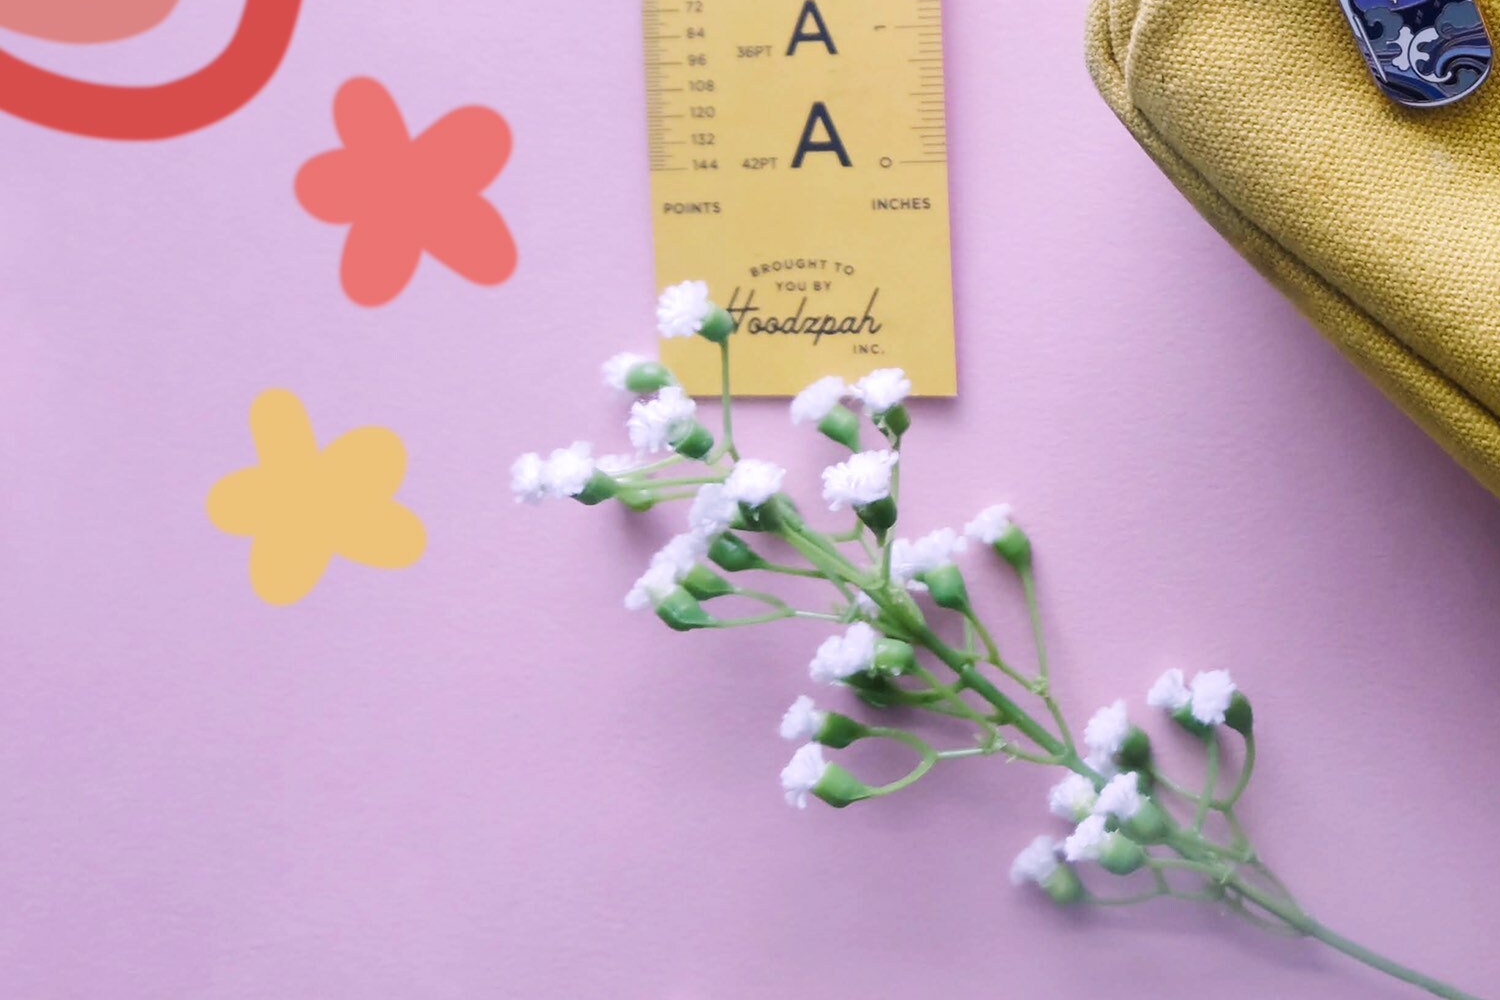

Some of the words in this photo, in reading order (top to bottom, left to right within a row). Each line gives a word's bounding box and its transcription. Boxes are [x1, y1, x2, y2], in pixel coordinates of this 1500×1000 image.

[685, 1, 704, 14] 72
[686, 27, 705, 40] 84
[735, 45, 773, 60] 36PT
[687, 54, 707, 67] 96
[688, 80, 716, 93] 108
[690, 106, 717, 119] 120
[690, 132, 716, 146] 132
[741, 157, 778, 171] 42PT
[790, 101, 853, 169] A
[692, 158, 720, 171] 144
[663, 201, 722, 215] POINTS
[871, 197, 932, 211] INCHES
[749, 258, 828, 279] BROUGHT
[834, 261, 855, 276] TO
[775, 281, 807, 292] YOU
[812, 281, 833, 292] BY
[726, 286, 883, 347] Hoodzpah
[852, 344, 886, 356] INC.
